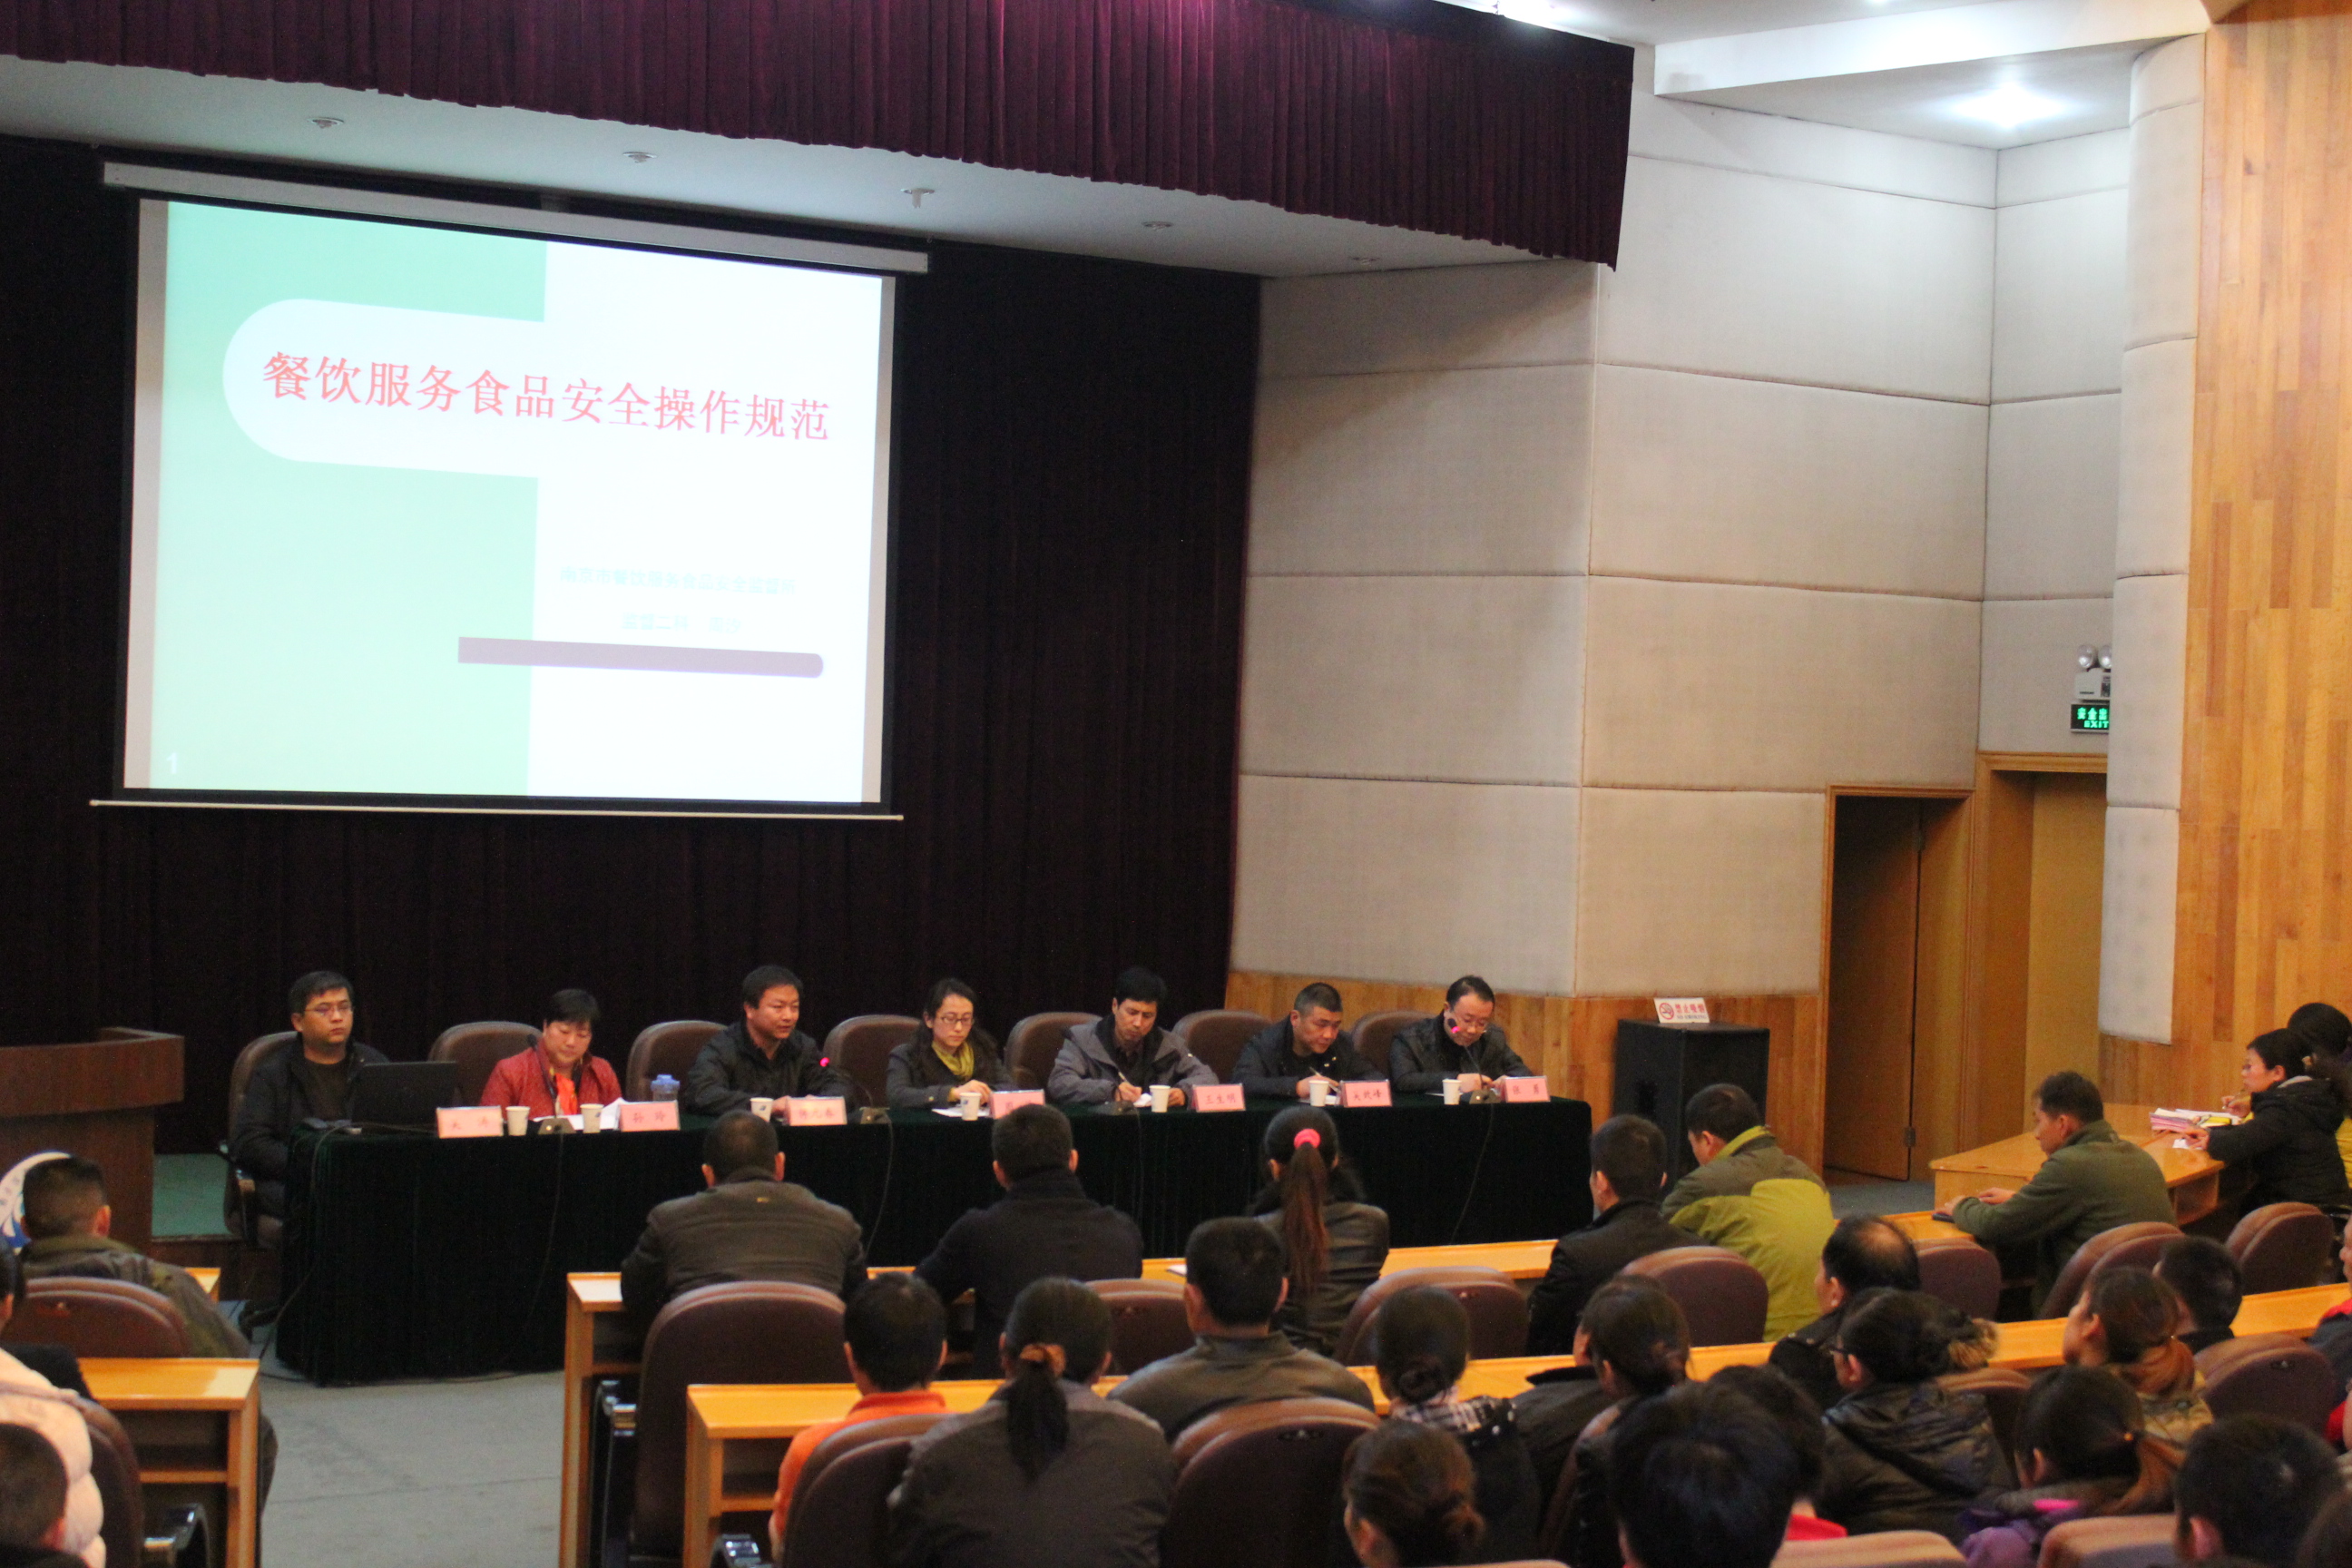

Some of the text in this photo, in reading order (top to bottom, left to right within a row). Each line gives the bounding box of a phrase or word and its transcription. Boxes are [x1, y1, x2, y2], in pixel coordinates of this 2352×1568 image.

[262, 350, 829, 441] 餐饮服务食品安全操作规范
[2077, 707, 2108, 720] 安全出
[2083, 720, 2109, 729] EXIT
[166, 752, 177, 774] 1
